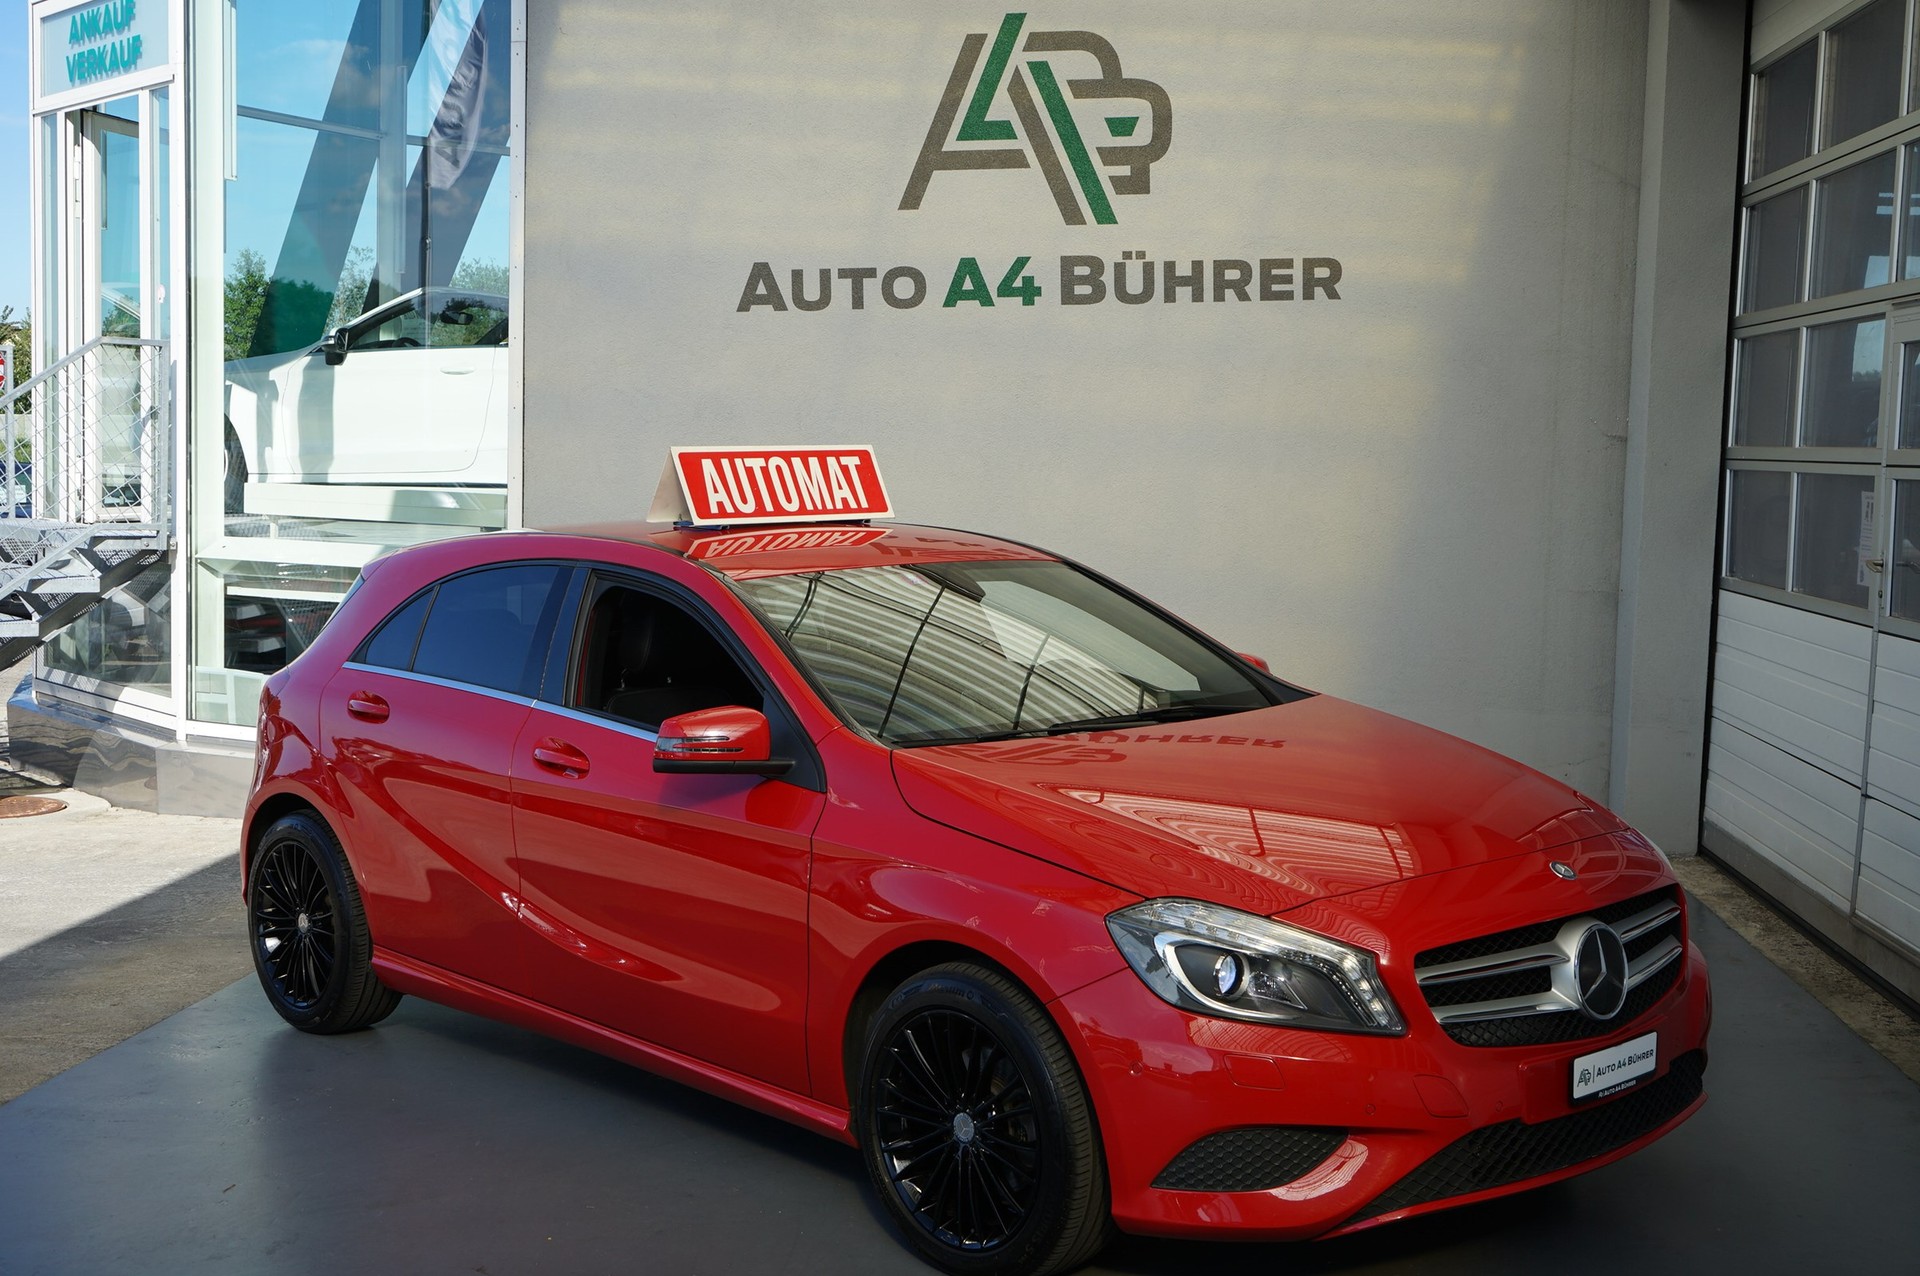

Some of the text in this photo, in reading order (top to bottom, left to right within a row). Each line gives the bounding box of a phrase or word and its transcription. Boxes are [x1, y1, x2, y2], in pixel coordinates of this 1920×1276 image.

[69, 0, 135, 44] ANKAUF
[66, 34, 141, 84] VERKAUF
[736, 251, 1342, 312] AUTO A4 BÜHRER
[701, 456, 869, 514] AUTOMAT
[1596, 1063, 1616, 1077] AUTO
[1617, 1058, 1627, 1070] A4
[1627, 1049, 1654, 1066] BÜHRER
